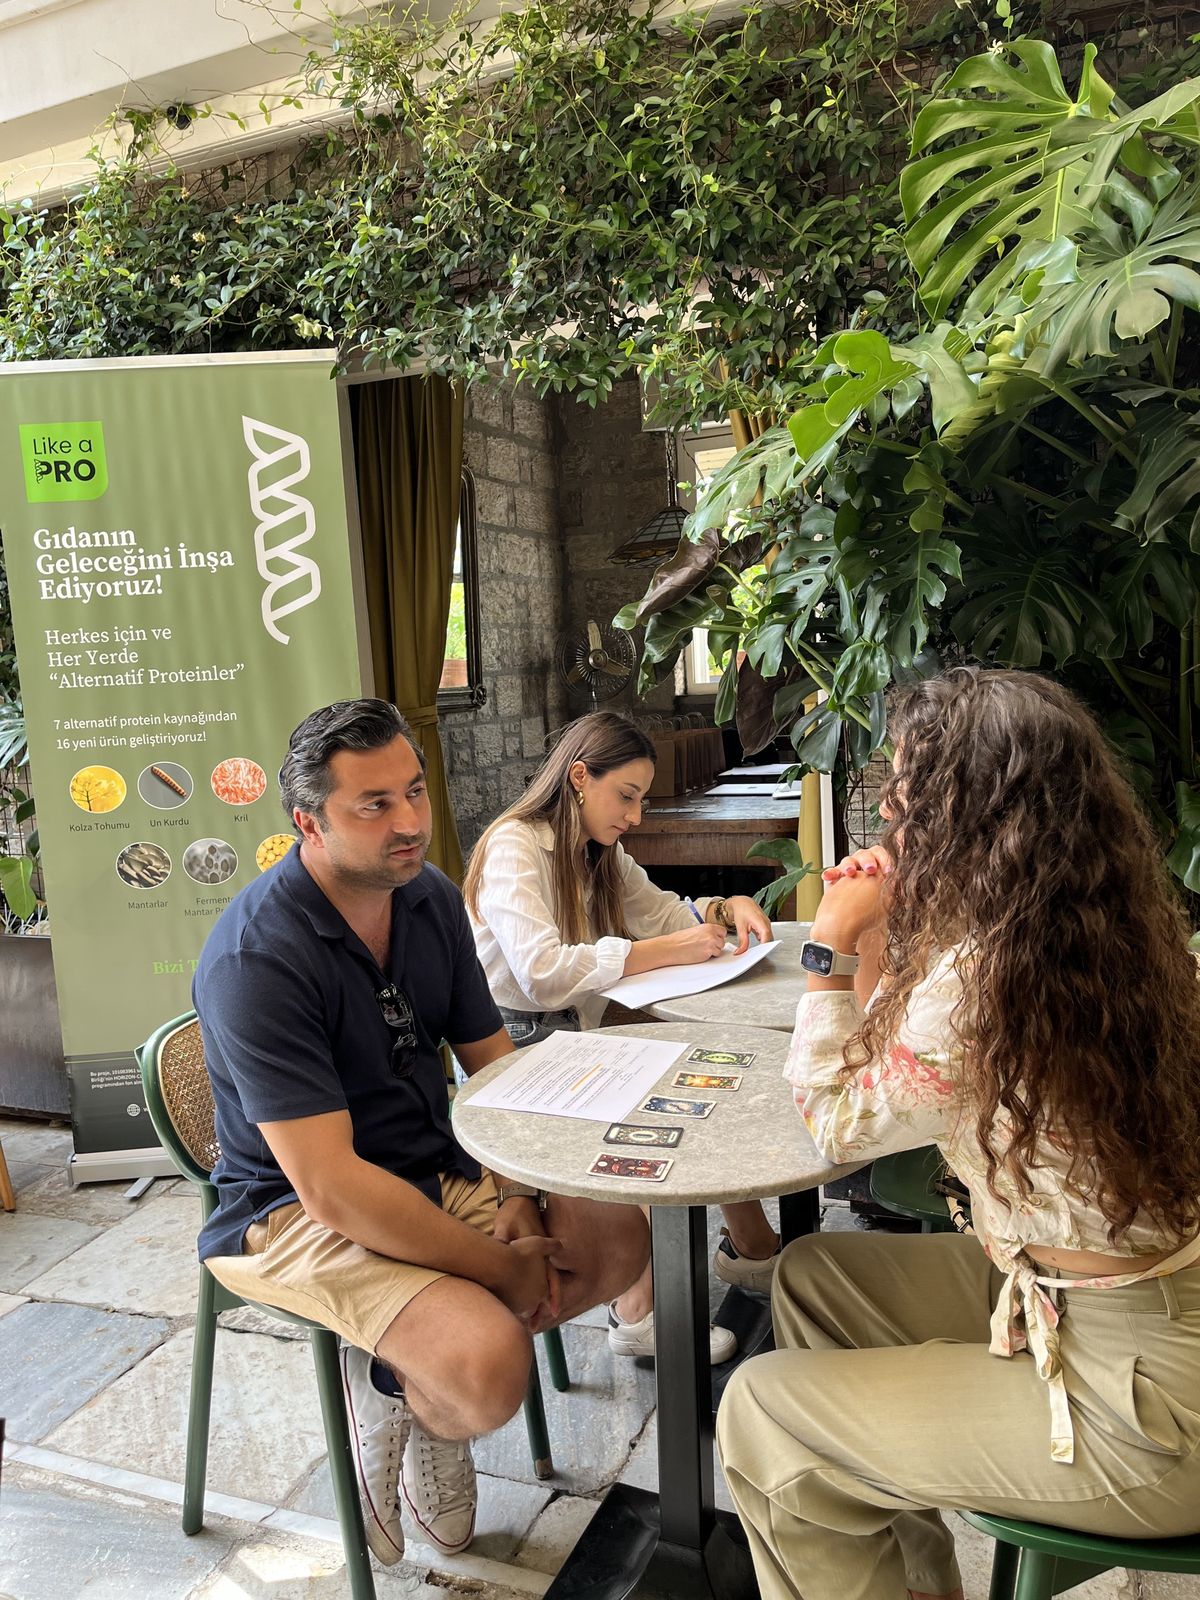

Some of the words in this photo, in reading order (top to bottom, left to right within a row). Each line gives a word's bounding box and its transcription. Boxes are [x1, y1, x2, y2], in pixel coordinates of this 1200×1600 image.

[33, 437, 72, 455] Like
[78, 438, 93, 453] a
[34, 458, 96, 484] PRO
[33, 526, 137, 550] Gıdanın
[36, 547, 173, 575] Geleceğini
[179, 543, 234, 573] İnşa
[39, 575, 164, 604] Ediyoruz!
[45, 627, 110, 645] Herkes
[113, 626, 147, 645] için
[151, 627, 172, 640] ve
[47, 651, 82, 668] Her
[85, 648, 139, 665] Yerde
[53, 719, 60, 730] 7
[63, 716, 117, 730] alternatif
[119, 714, 161, 729] protein
[164, 710, 237, 725] kaynağından
[56, 738, 70, 750] 16
[72, 737, 97, 751] yeni
[99, 735, 127, 748] ürün
[129, 731, 207, 748] geliştiriyoruz!
[69, 822, 94, 832] Kolza
[94, 820, 130, 831] Tohumu
[150, 818, 162, 828] Un
[163, 817, 190, 827] Kurdu
[234, 814, 249, 823] Kril
[128, 899, 168, 909] Mantarlar
[184, 908, 213, 917] Mantar
[152, 959, 184, 975] Bizi
